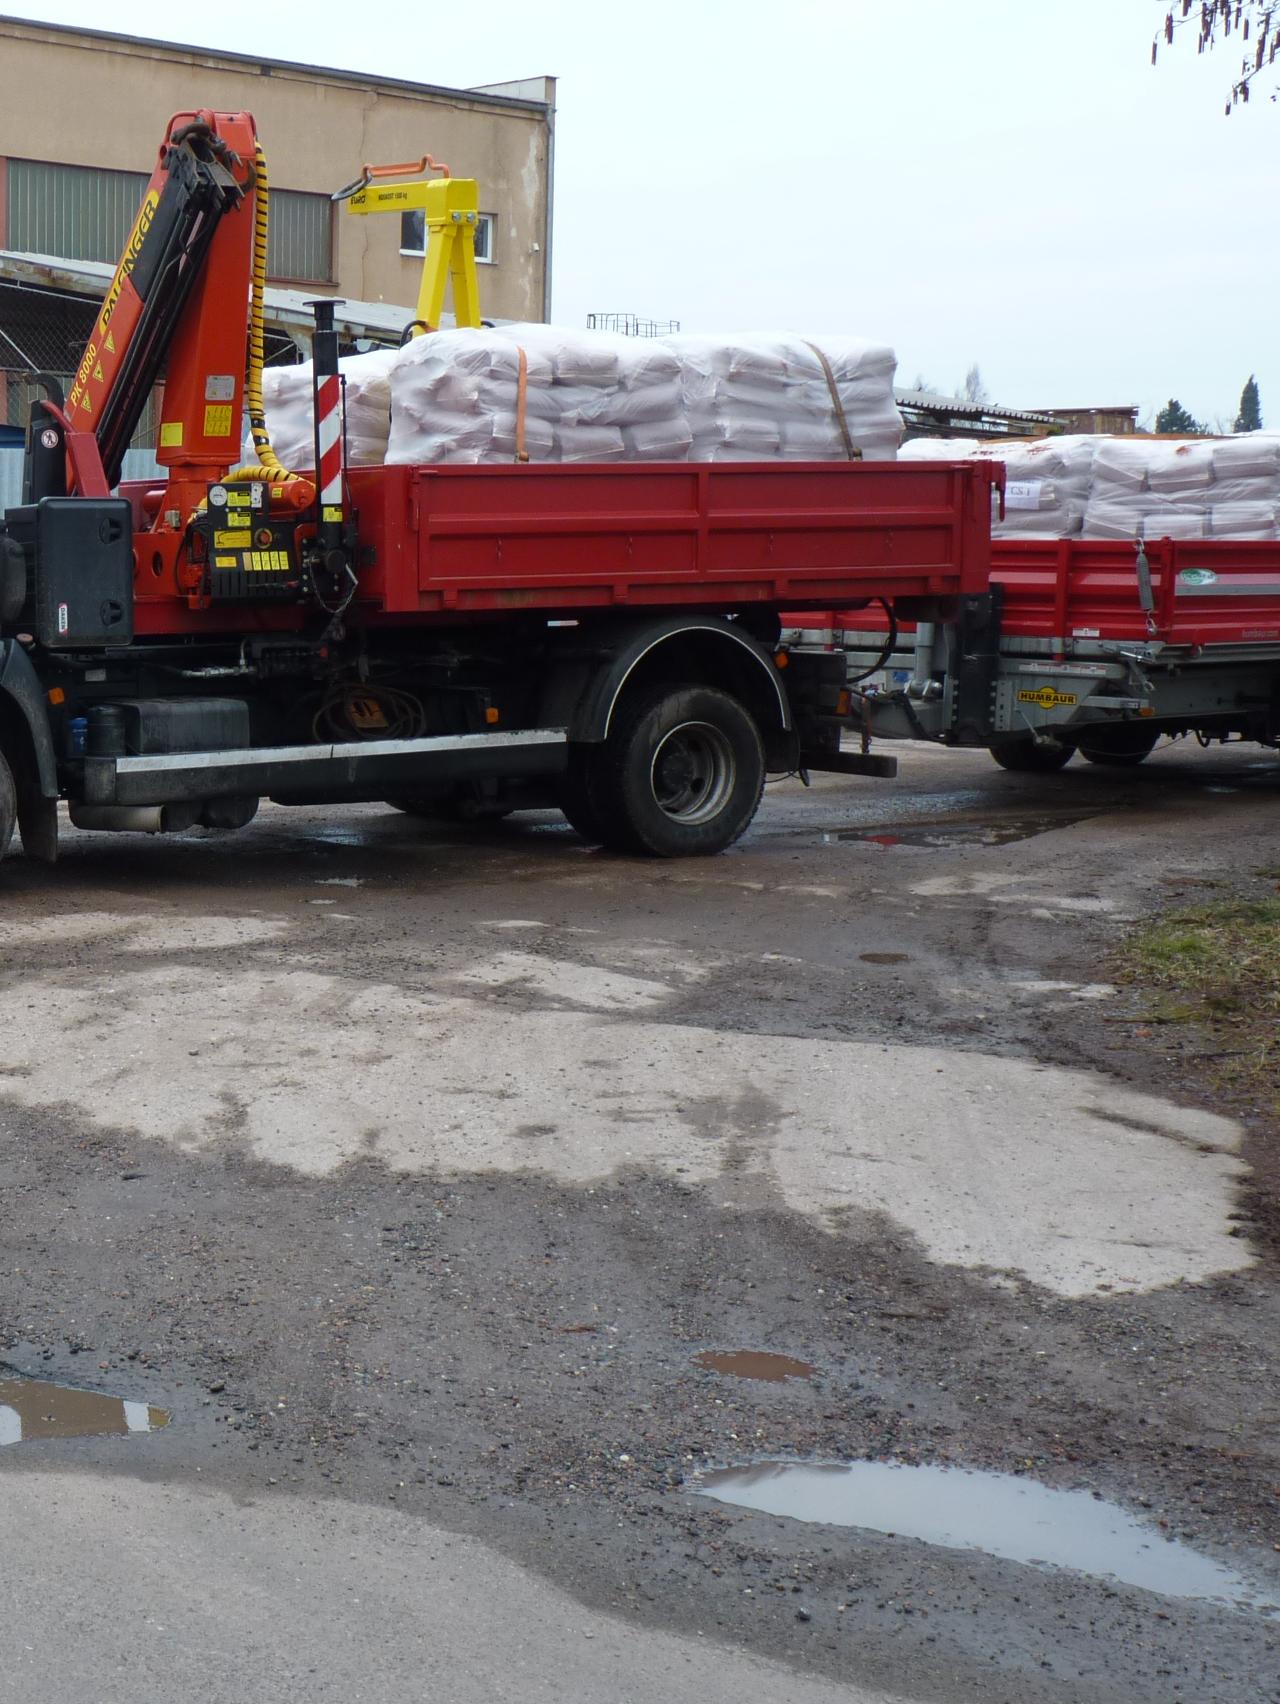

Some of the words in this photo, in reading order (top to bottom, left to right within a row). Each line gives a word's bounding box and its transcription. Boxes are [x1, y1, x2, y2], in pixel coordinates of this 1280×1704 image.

[70, 382, 83, 407] PK
[79, 344, 97, 384] 8000
[1019, 692, 1075, 704] HUMBAUR
